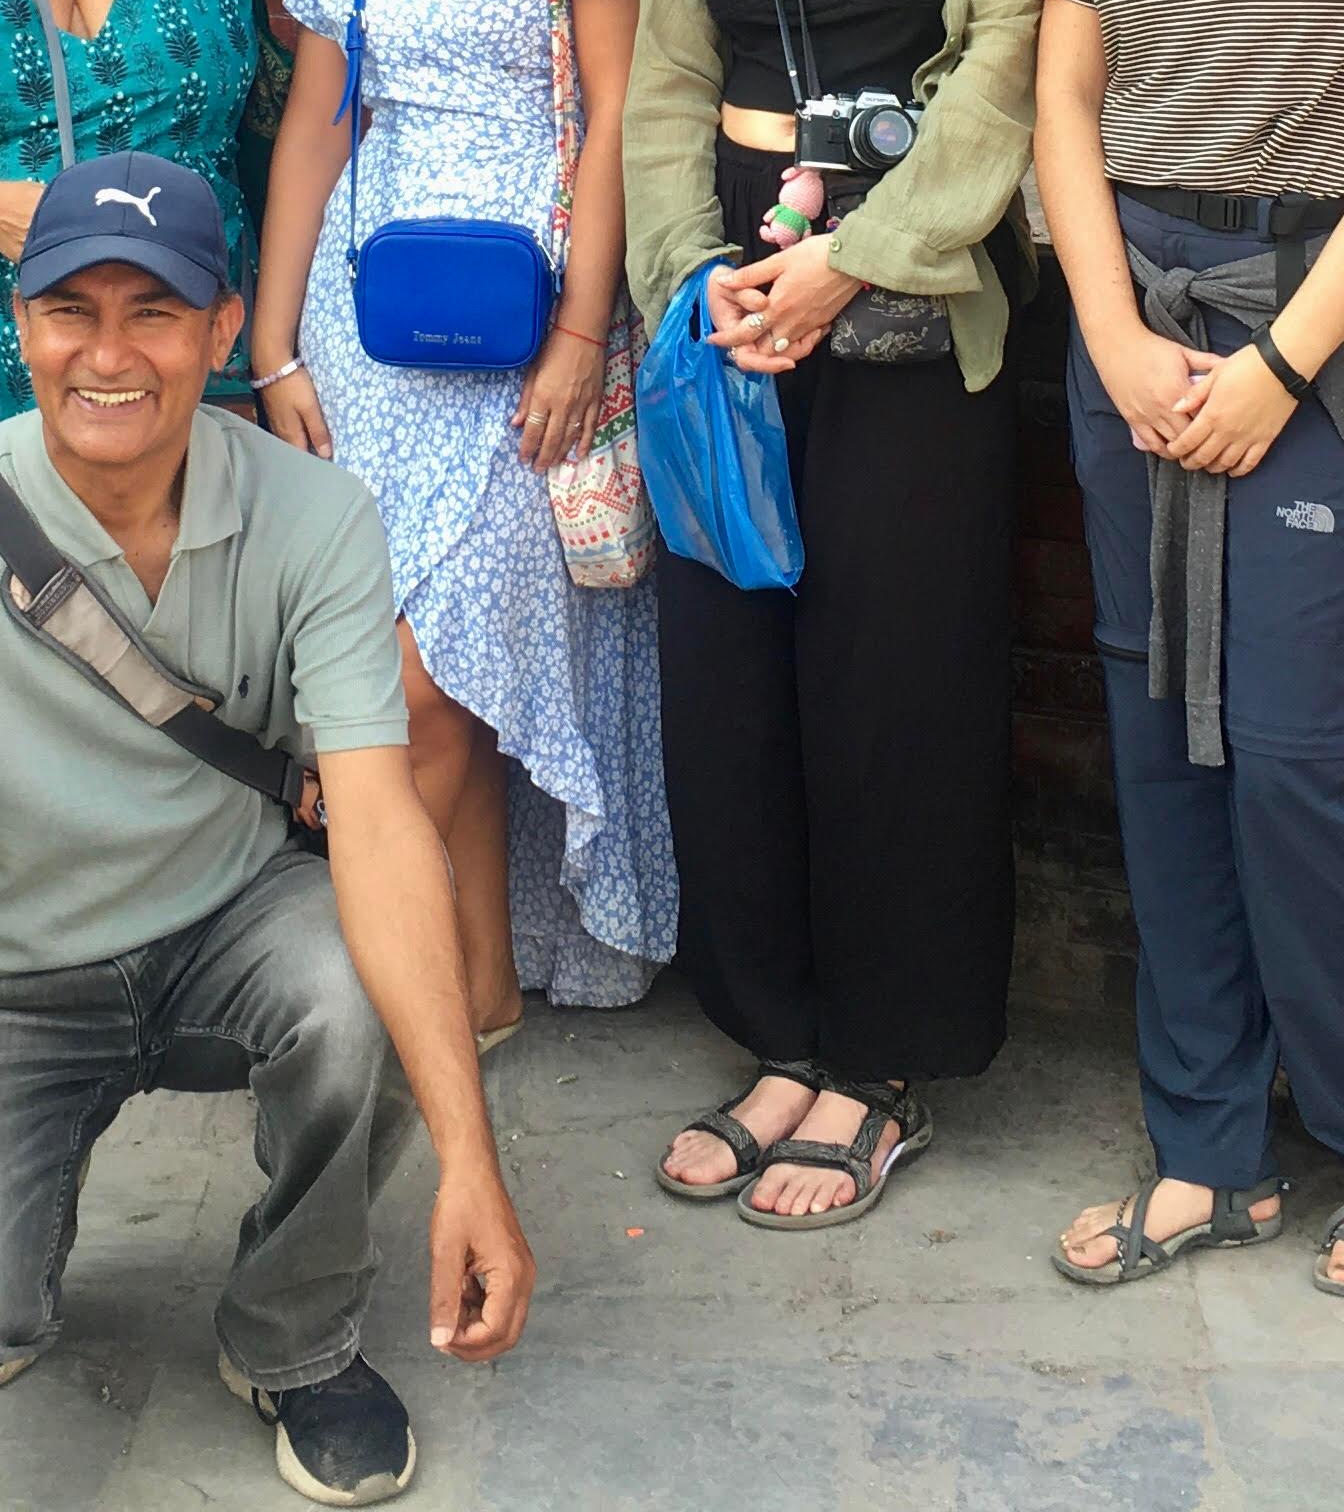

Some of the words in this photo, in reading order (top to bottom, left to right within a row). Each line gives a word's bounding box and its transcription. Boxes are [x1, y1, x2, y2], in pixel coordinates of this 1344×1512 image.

[1293, 500, 1316, 512] THE
[1276, 505, 1315, 522] NORTH
[1285, 517, 1316, 530] FACE
